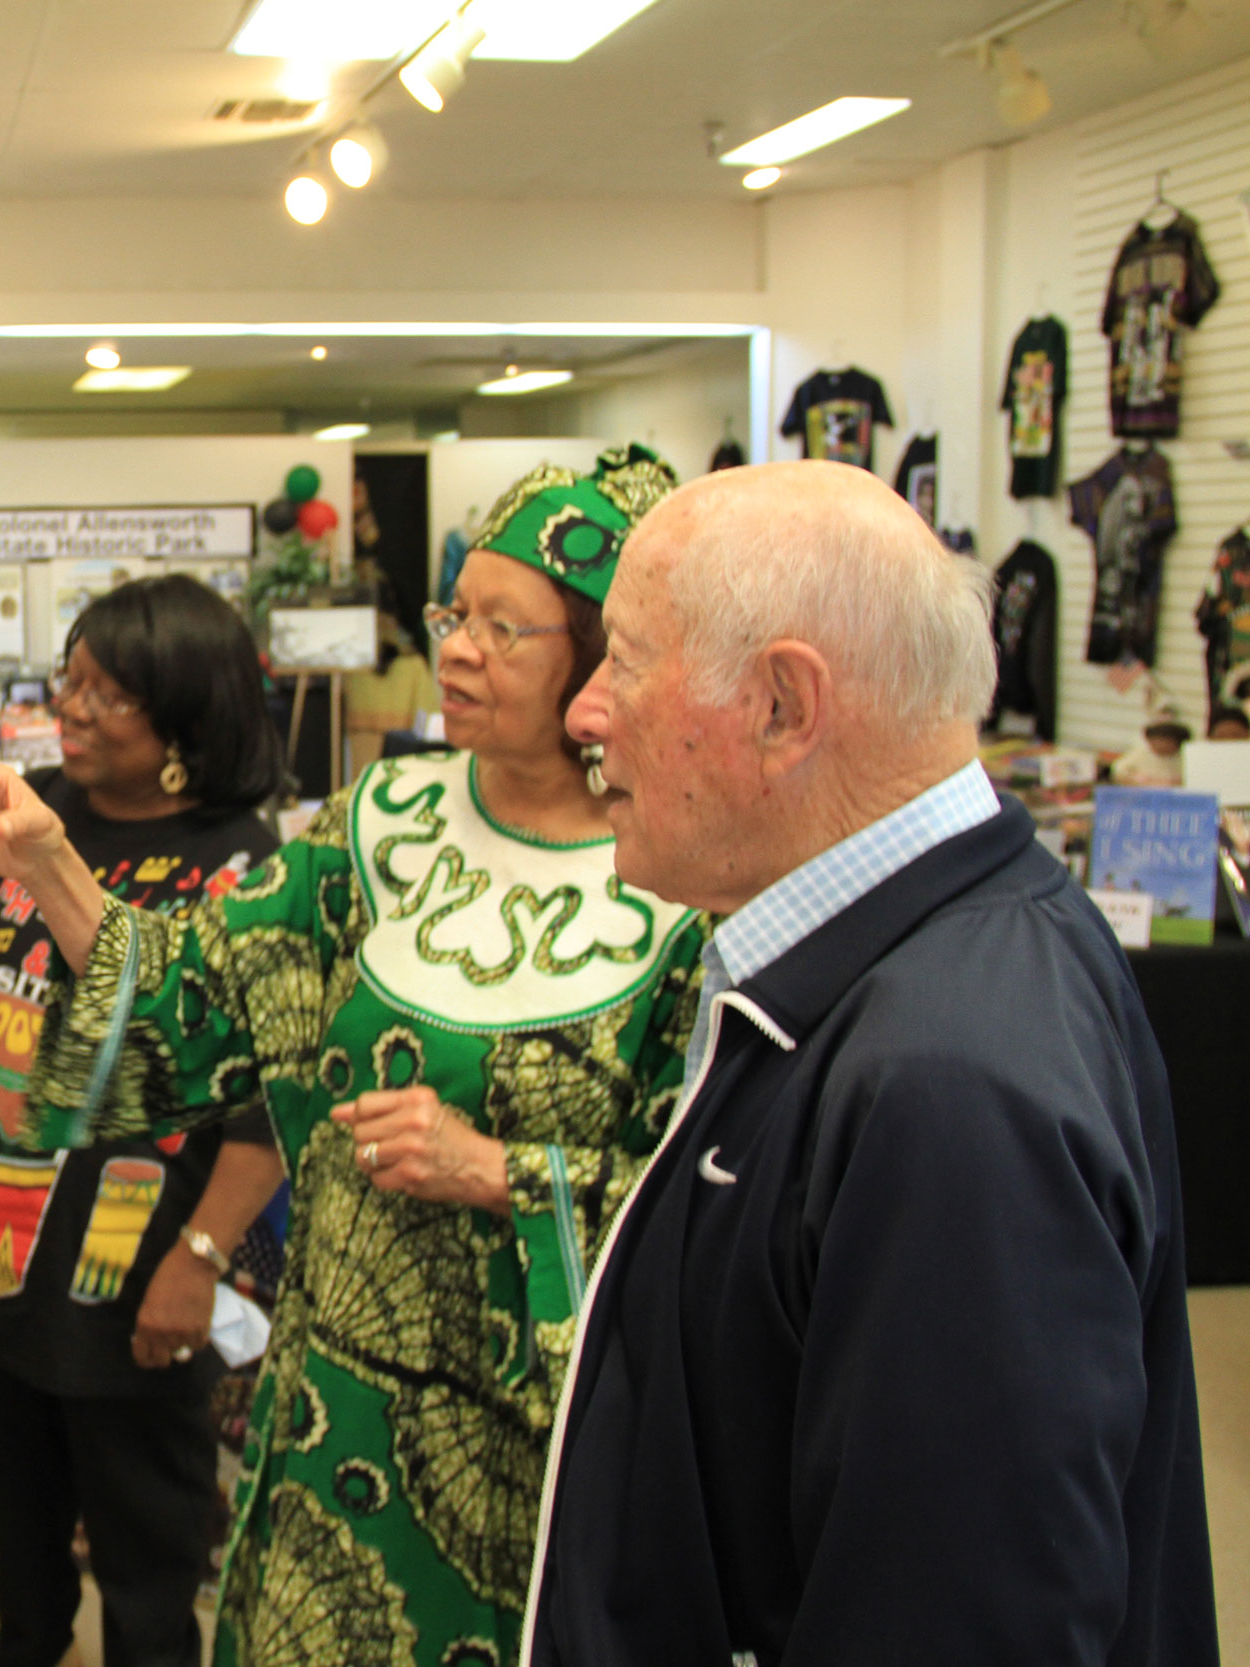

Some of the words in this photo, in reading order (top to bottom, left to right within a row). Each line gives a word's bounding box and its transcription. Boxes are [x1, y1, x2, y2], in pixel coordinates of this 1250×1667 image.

[77, 513, 216, 533] Allensworth
[56, 534, 145, 555] Historic
[156, 533, 206, 553] Park
[1123, 838, 1206, 869] SING
[23, 940, 50, 978] &
